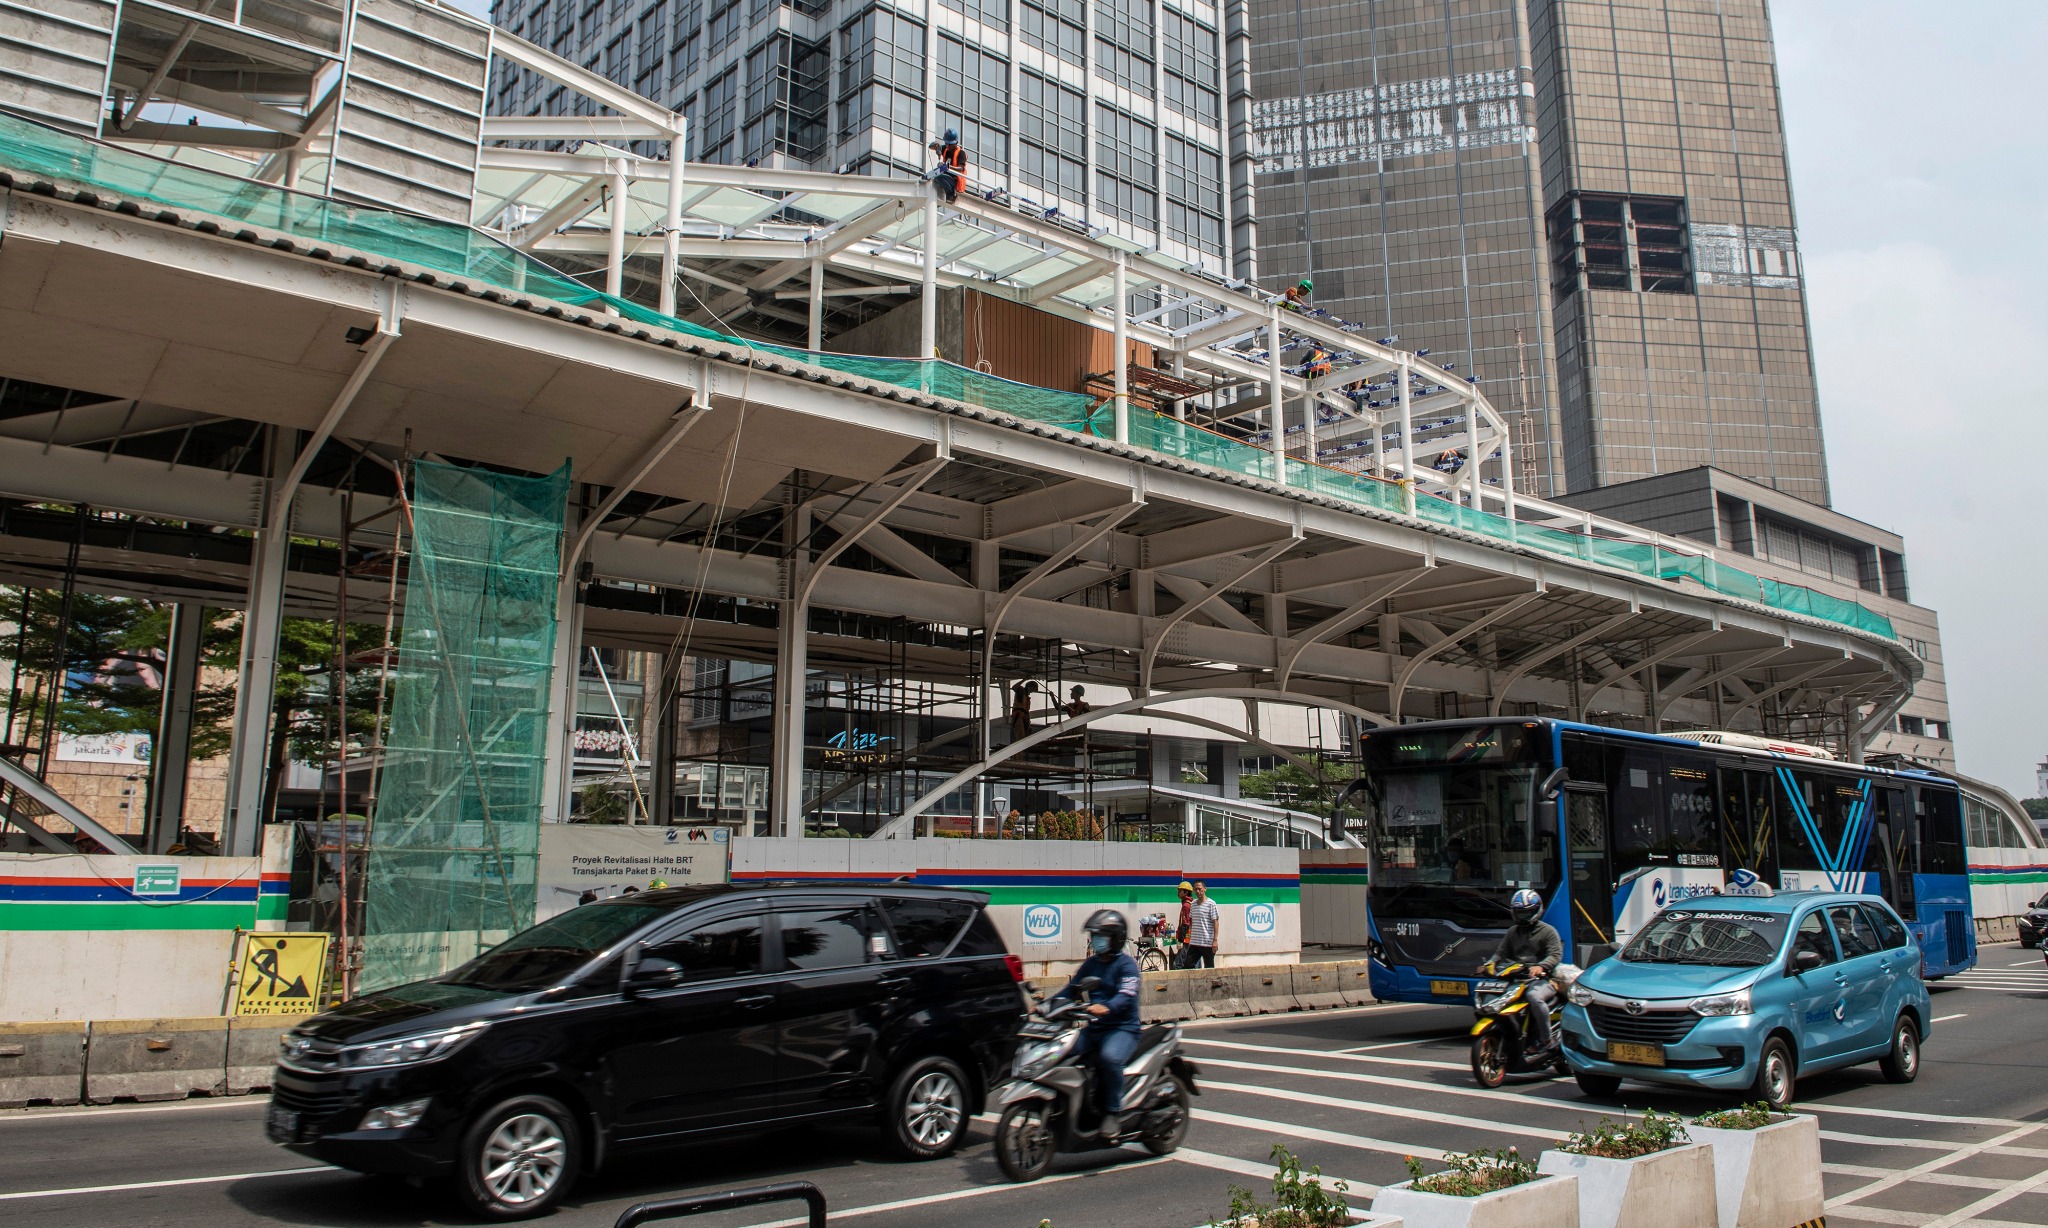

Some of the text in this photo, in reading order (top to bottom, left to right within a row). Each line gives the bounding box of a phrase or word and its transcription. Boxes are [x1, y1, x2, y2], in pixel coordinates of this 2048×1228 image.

[572, 855, 694, 866] Proyek Revitalisasi Halte BRT
[572, 867, 624, 877] Transjakarta
[625, 867, 649, 875] Paket
[650, 867, 657, 875] B
[664, 867, 669, 875] 7
[671, 867, 692, 875] Halte
[1731, 888, 1761, 896] TAKSI
[1028, 914, 1058, 928] WiKA
[1248, 911, 1272, 924] WiKA
[1693, 912, 1775, 923] Bluebird Group
[1396, 922, 1408, 936] SAF
[1408, 923, 1420, 936] 110
[243, 1007, 270, 1015] HATI
